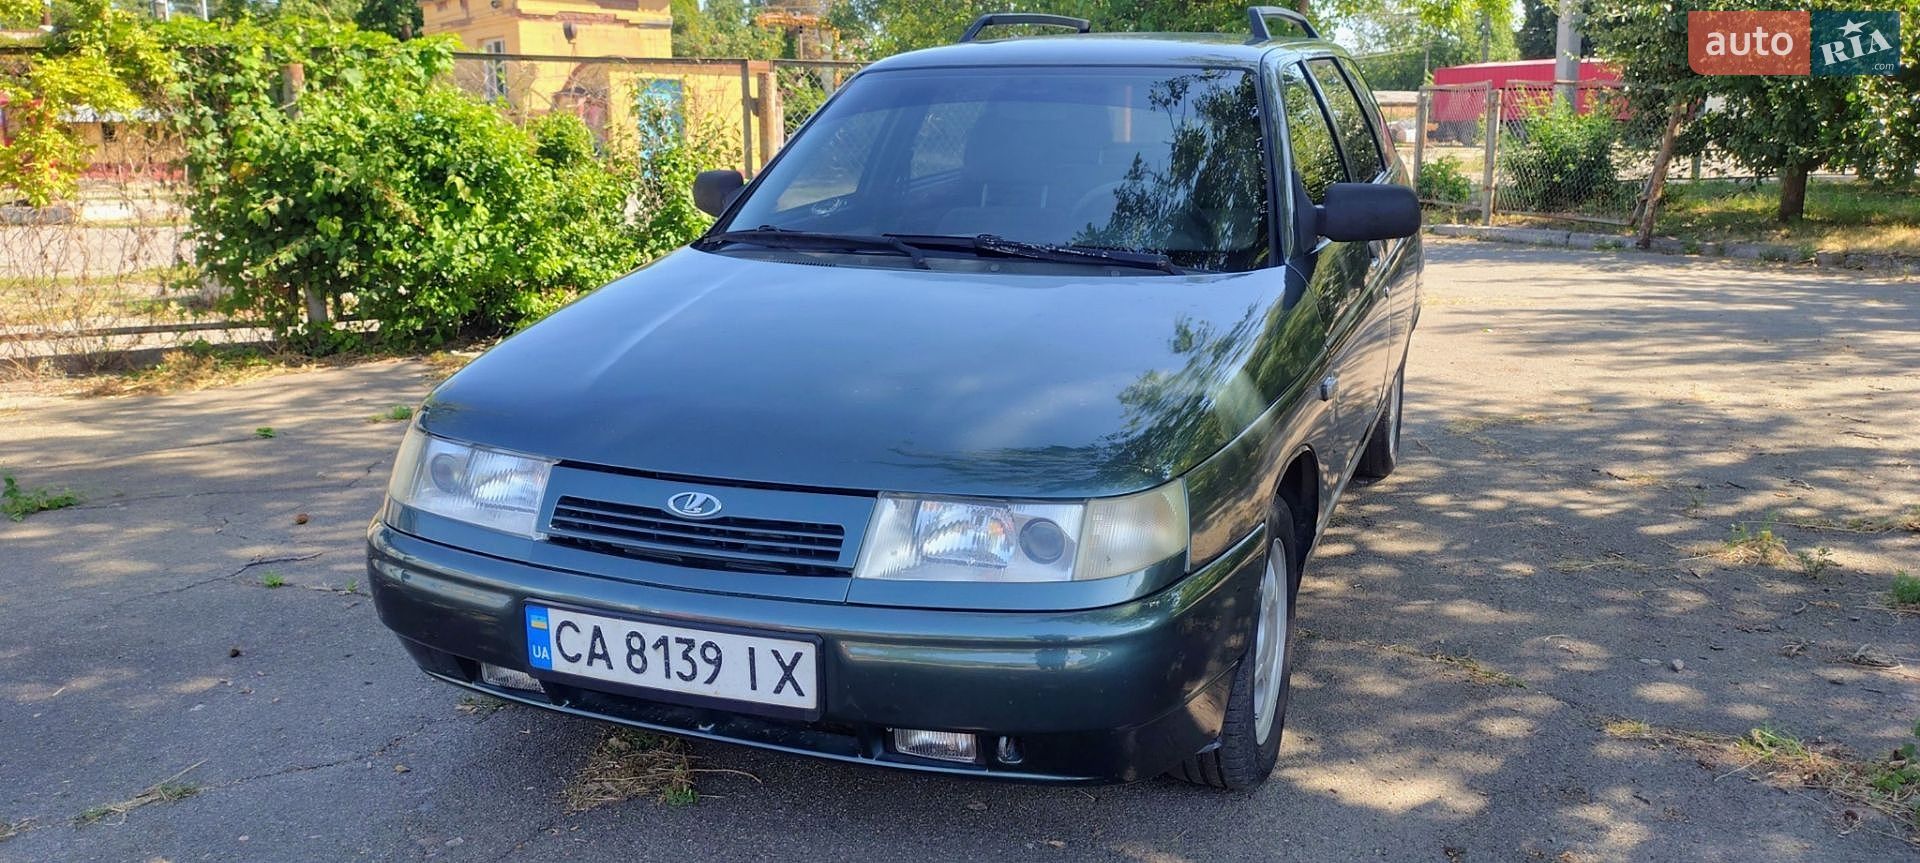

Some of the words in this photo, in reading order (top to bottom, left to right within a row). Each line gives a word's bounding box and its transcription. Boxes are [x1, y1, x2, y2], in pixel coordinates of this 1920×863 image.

[532, 645, 550, 660] UA
[555, 620, 613, 670] CA
[625, 631, 722, 684] 8139
[748, 647, 805, 697] IX
